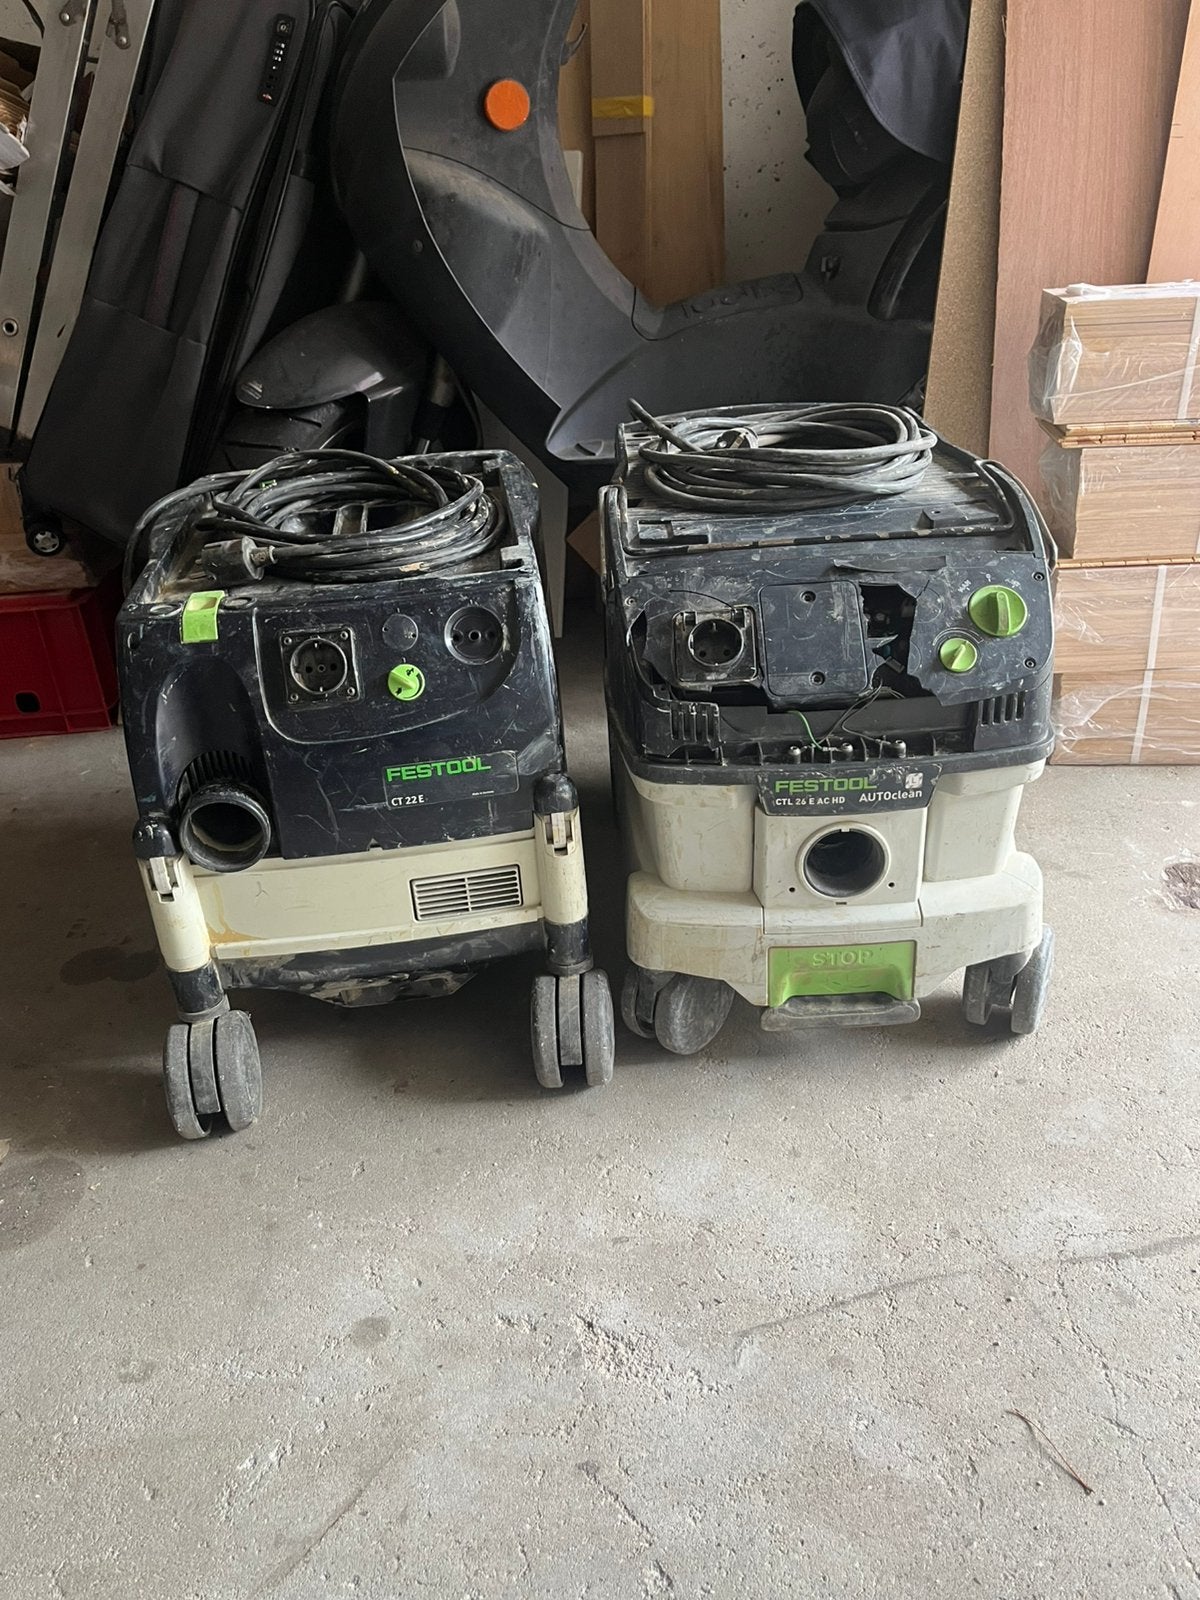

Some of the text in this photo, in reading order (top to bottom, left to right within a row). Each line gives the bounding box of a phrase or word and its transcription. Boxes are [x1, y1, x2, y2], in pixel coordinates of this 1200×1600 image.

[386, 757, 491, 782] FESTOOL
[775, 777, 877, 794] FESTOOL
[391, 794, 425, 806] CT 22 E
[775, 798, 793, 806] CTL
[832, 796, 845, 804] HD
[859, 790, 923, 803] AUTOclean
[812, 950, 873, 967] STOP
